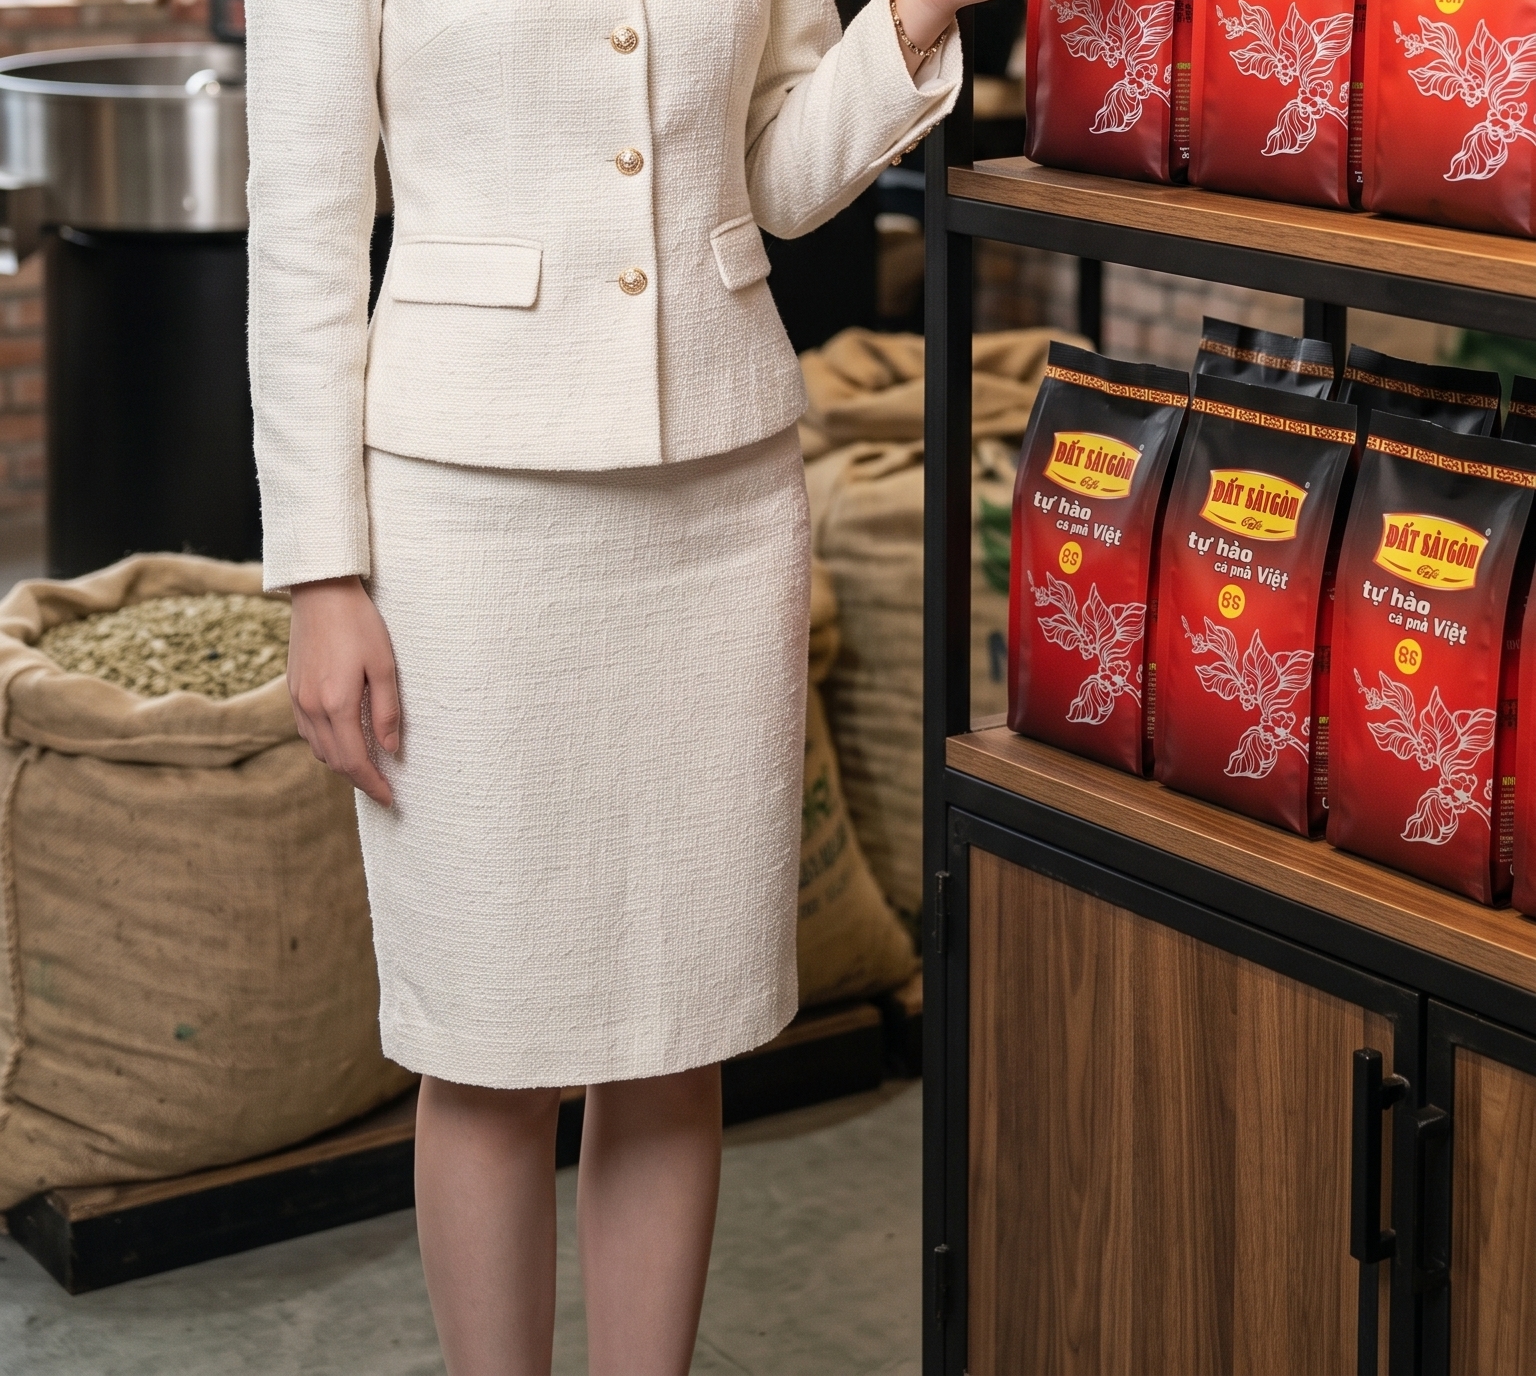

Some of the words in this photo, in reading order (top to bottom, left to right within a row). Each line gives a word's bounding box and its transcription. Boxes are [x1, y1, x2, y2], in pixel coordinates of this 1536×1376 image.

[1034, 491, 1057, 513] tự
[1058, 497, 1091, 520] hào
[1093, 523, 1122, 547] Việt
[1188, 532, 1214, 555] tự
[1216, 538, 1253, 563] hào
[1257, 566, 1288, 591] Việt
[1363, 581, 1389, 606] tự
[1391, 588, 1431, 615] hào
[1433, 618, 1467, 645] Việt
